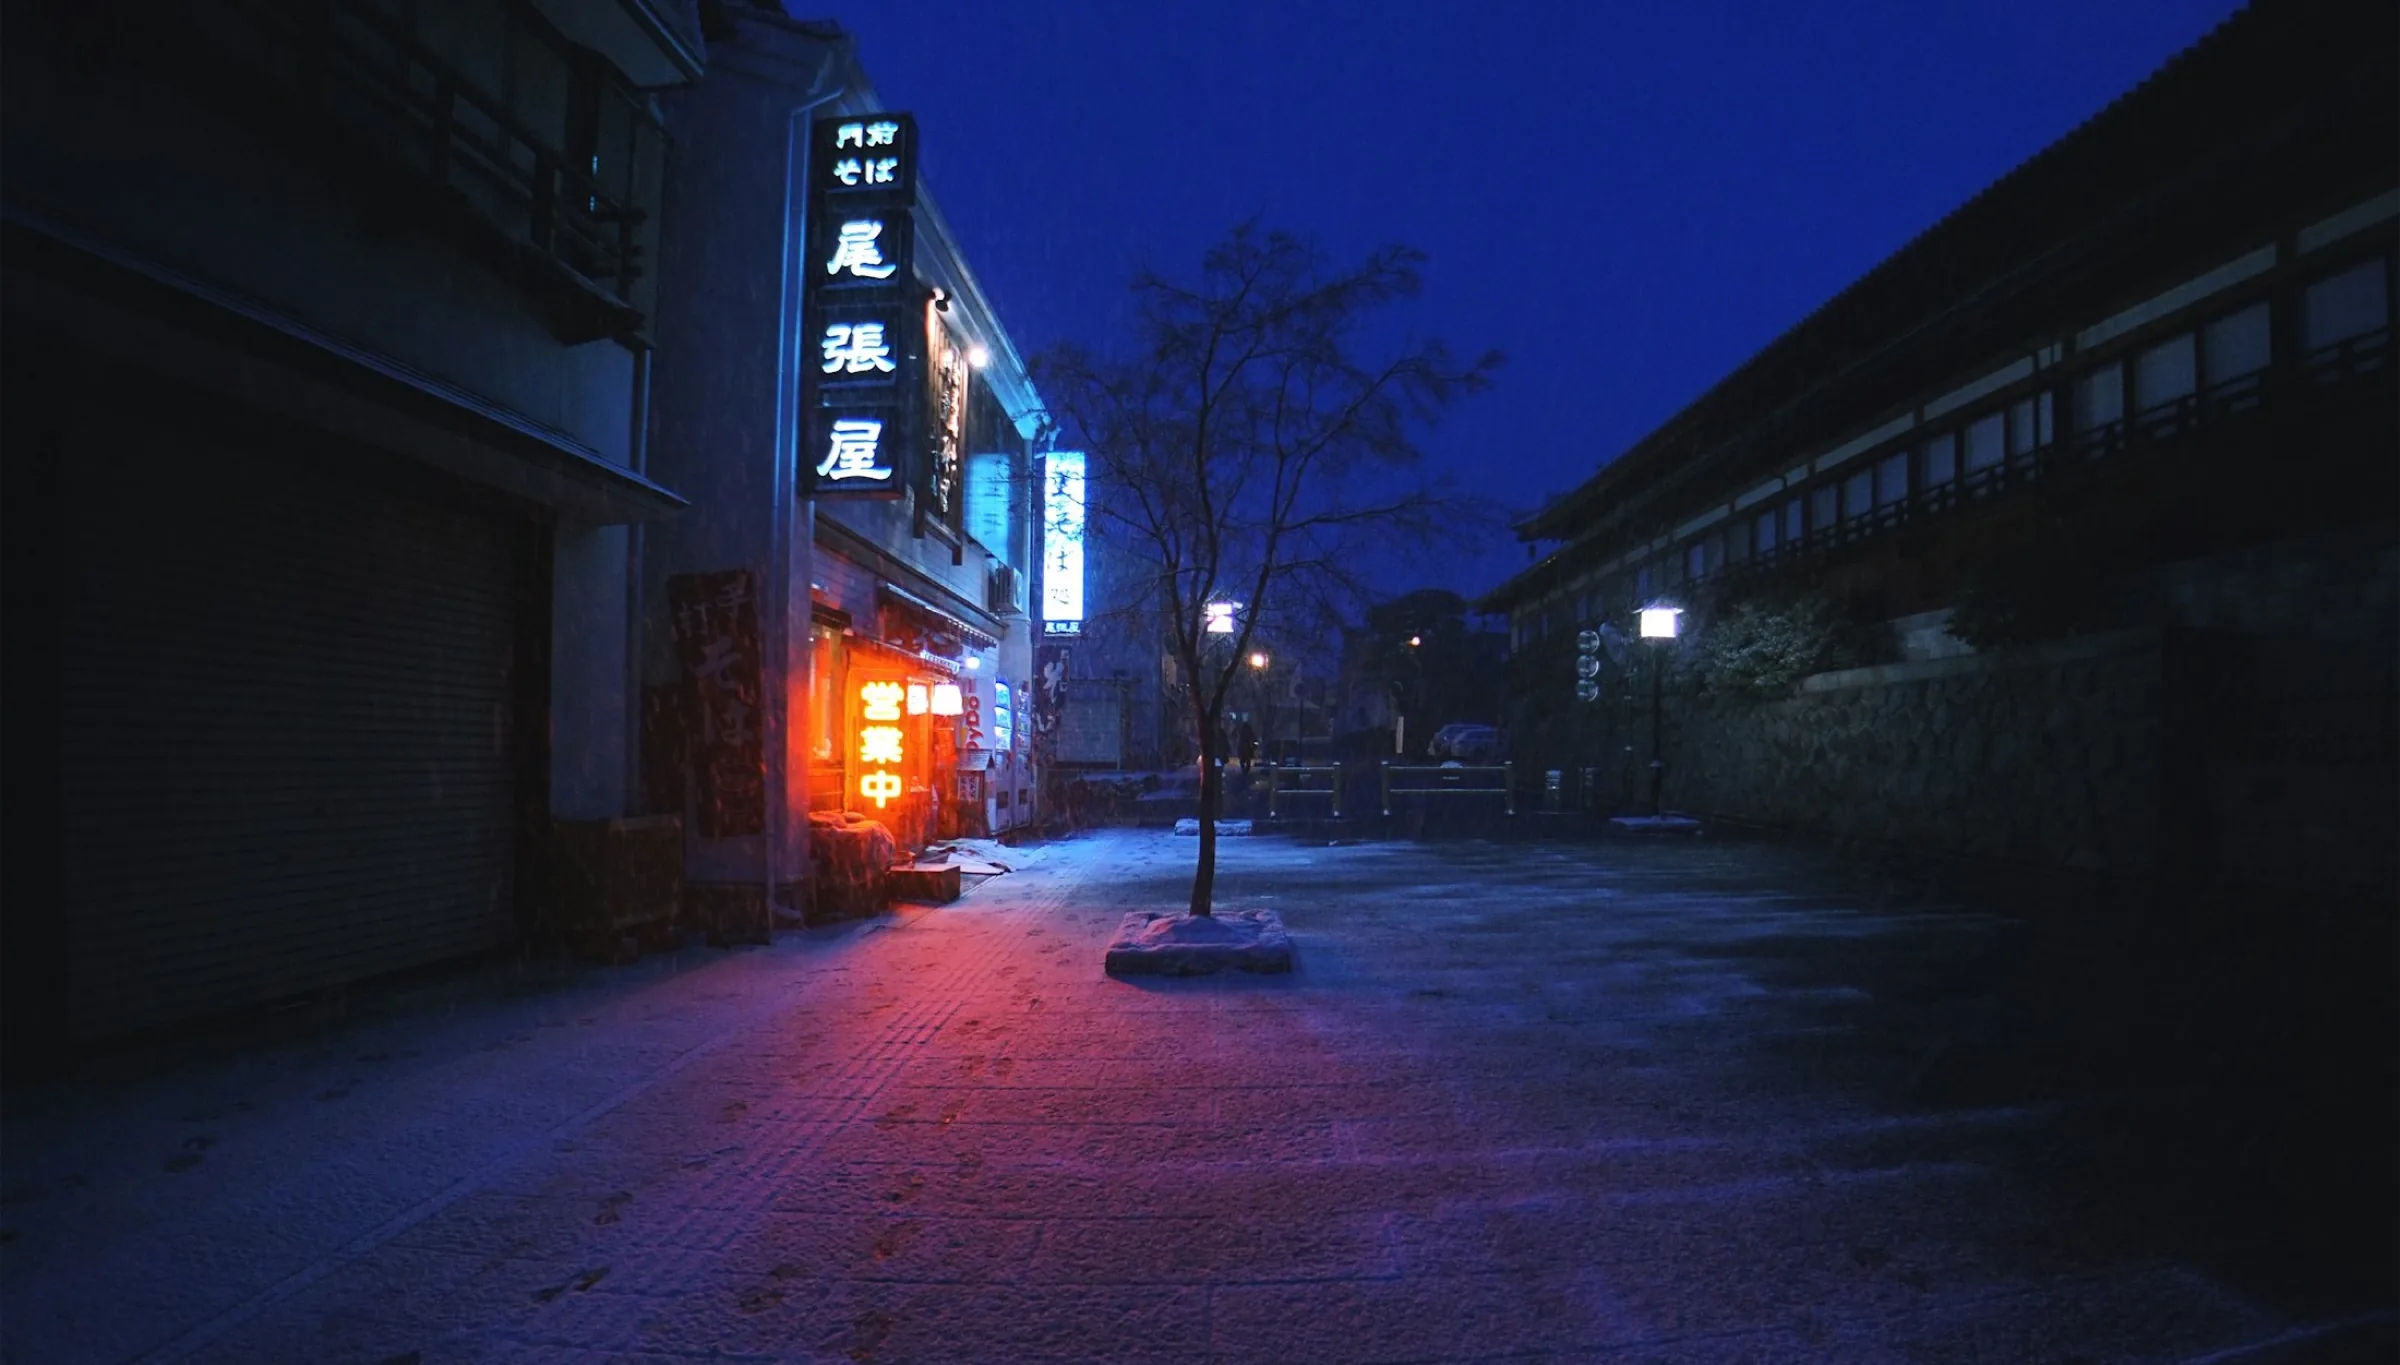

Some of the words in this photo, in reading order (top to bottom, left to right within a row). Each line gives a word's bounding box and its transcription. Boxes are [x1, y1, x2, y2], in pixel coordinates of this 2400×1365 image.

[833, 156, 898, 186] そば
[836, 121, 899, 149] 門前
[816, 219, 897, 481] 尾張屋
[861, 681, 904, 808] 営業中
